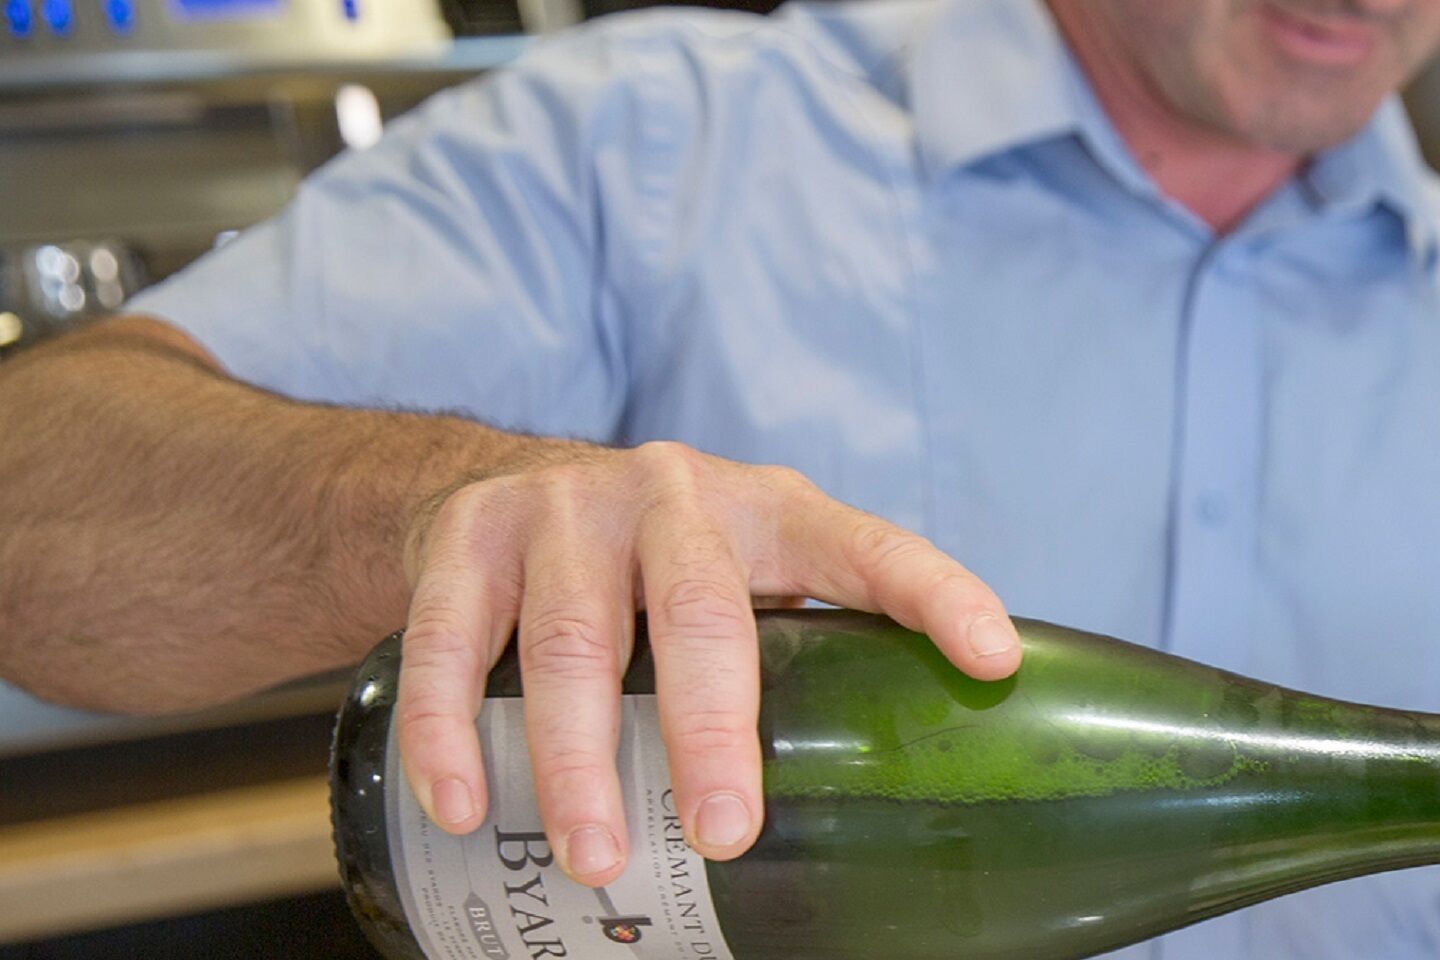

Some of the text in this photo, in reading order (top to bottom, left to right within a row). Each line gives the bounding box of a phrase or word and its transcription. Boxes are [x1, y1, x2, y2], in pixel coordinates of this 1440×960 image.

[647, 788, 662, 878] APPELLATION
[661, 788, 705, 934] CRÉMANT
[469, 906, 506, 956] BRUT
